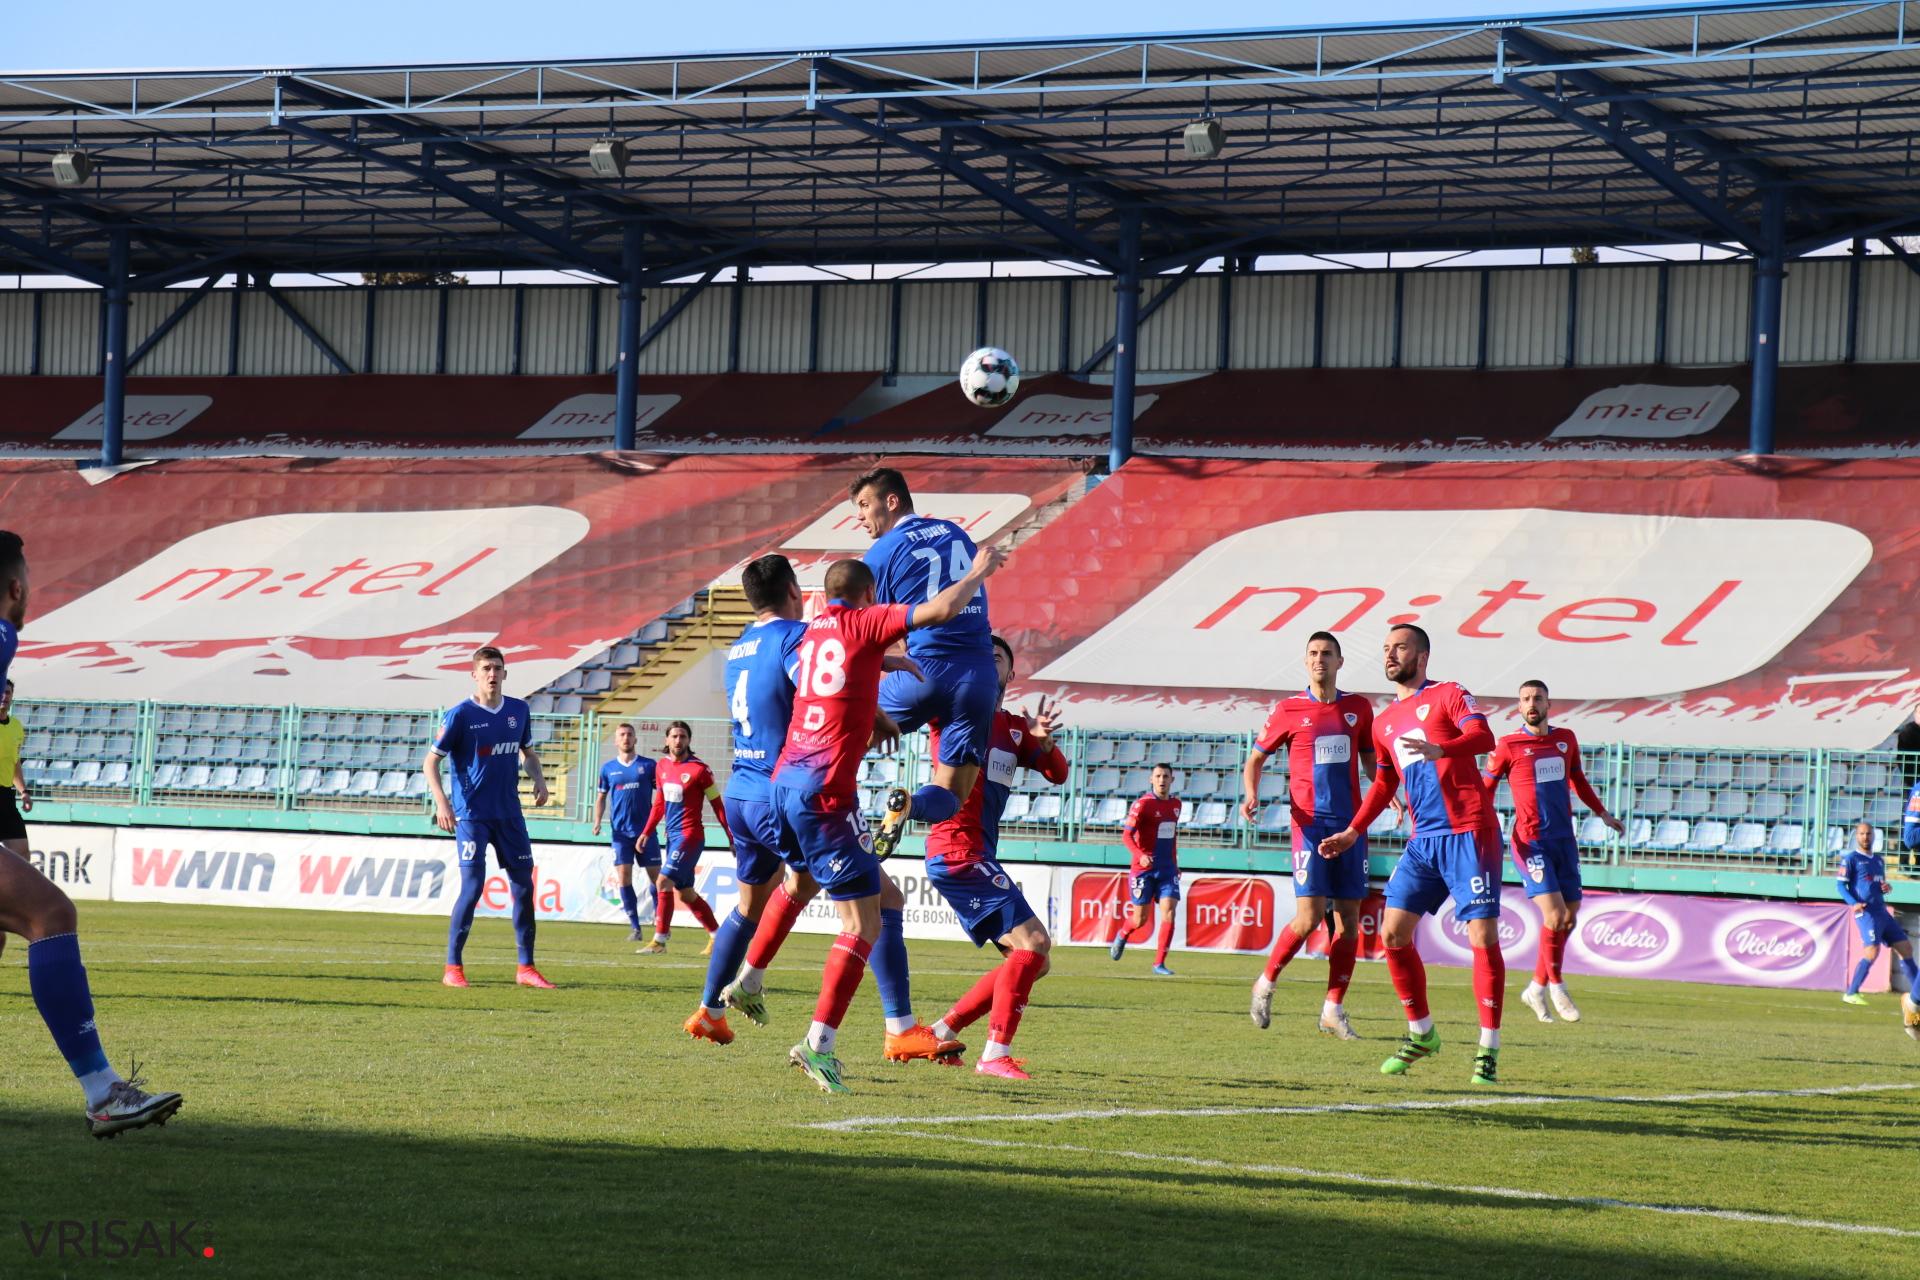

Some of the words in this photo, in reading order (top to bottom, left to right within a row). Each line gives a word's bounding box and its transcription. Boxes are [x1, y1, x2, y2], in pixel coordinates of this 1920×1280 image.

[551, 406, 656, 425] m:tl
[1585, 401, 1711, 421] m:tel
[134, 547, 499, 602] m:tel
[1193, 579, 1742, 646] m:tel
[800, 638, 846, 698] 18
[731, 669, 752, 737] 4
[1319, 742, 1347, 755] m:tel
[846, 808, 868, 836] 18
[461, 841, 477, 861] 29
[1293, 850, 1311, 869] 17
[974, 861, 999, 877] 11
[1526, 855, 1545, 871] 95
[1130, 877, 1145, 889] 33
[1470, 871, 1490, 895] e!
[1080, 898, 1137, 920] m:te
[1195, 899, 1264, 928] m:tel
[1591, 921, 1659, 950] Violeta
[1735, 929, 1806, 958] Violeta
